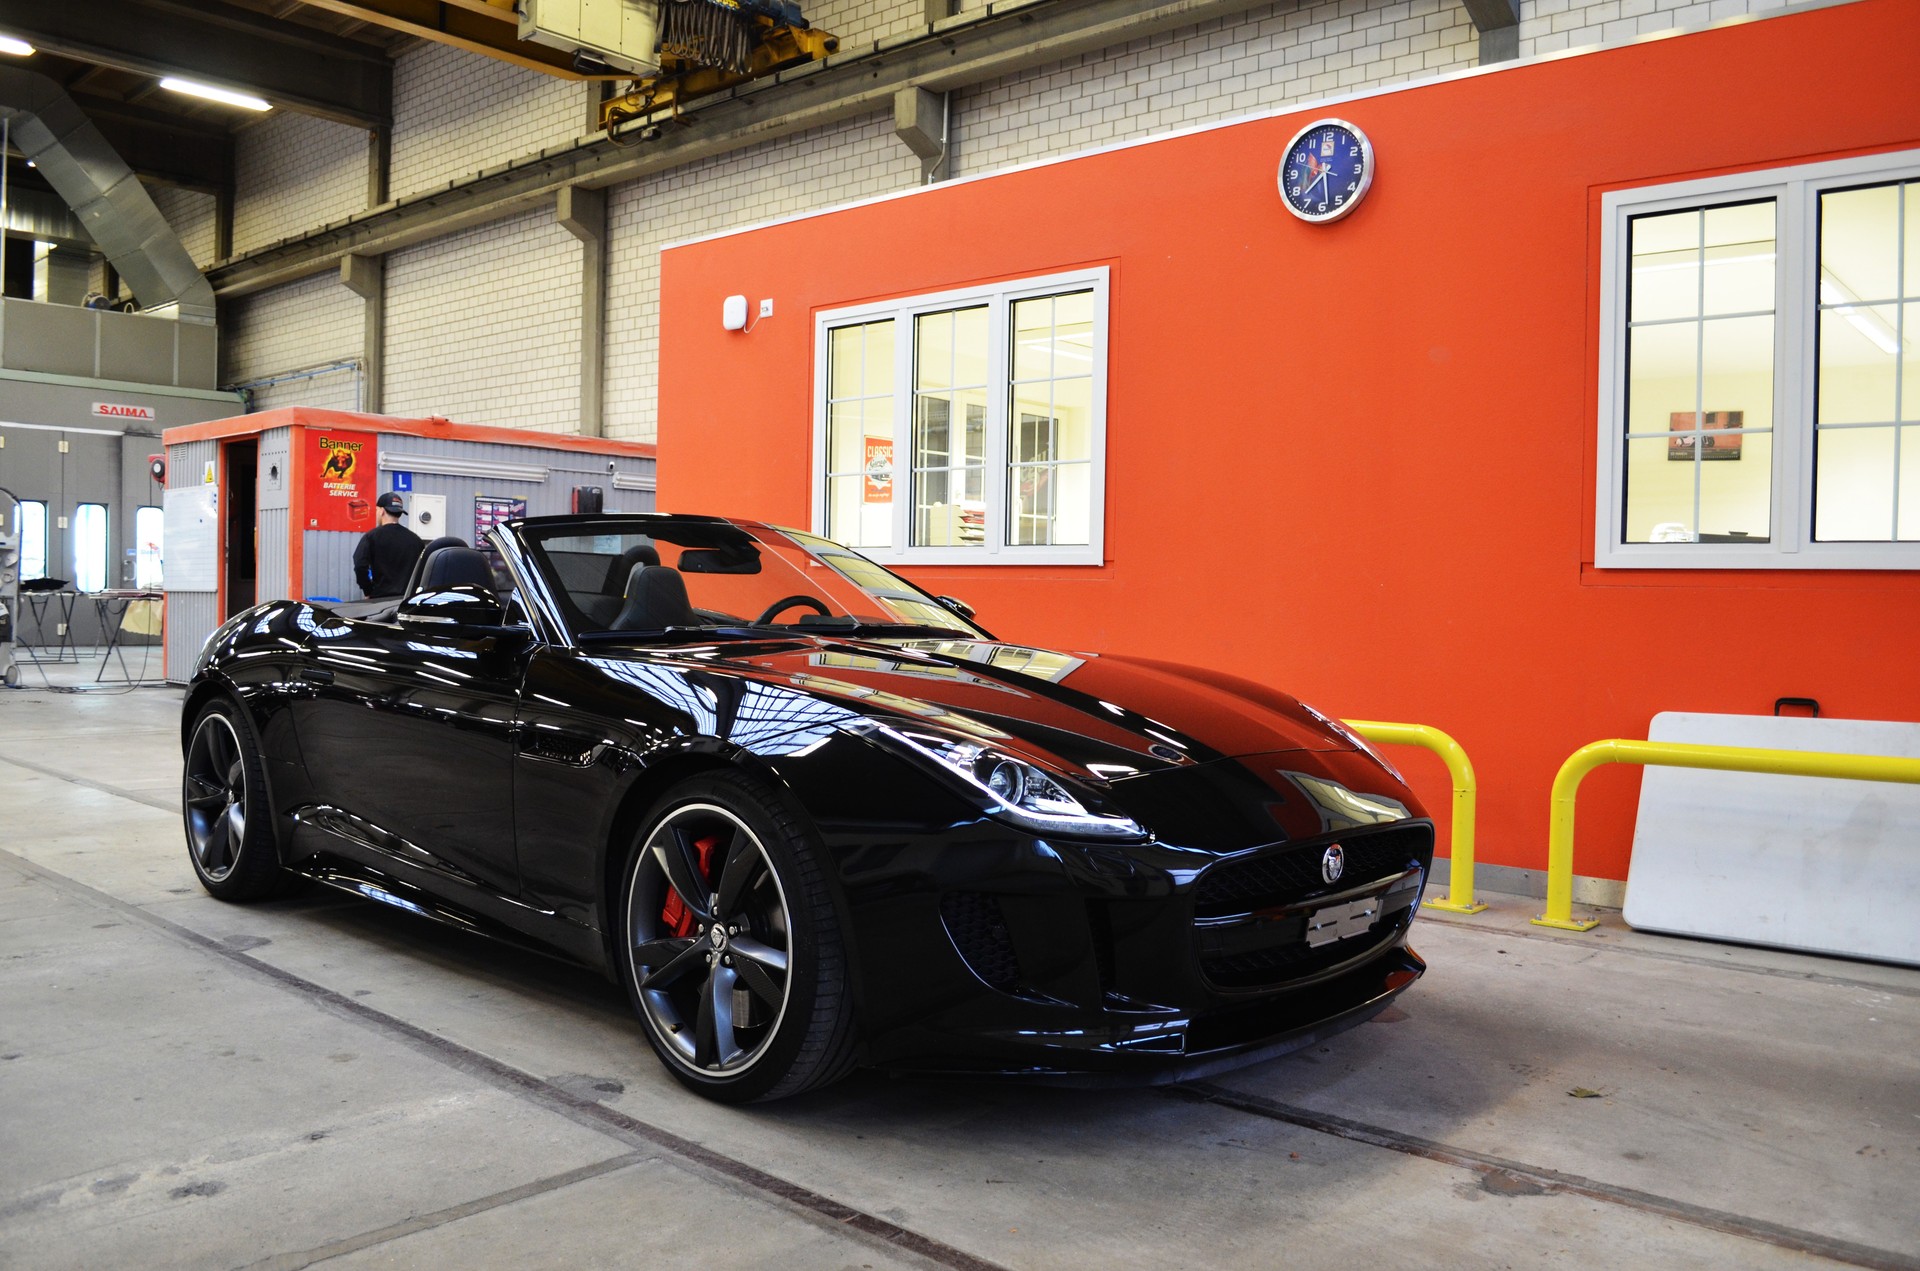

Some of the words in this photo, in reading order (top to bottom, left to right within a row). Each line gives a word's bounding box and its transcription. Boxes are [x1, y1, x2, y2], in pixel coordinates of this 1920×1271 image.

[1323, 132, 1334, 142] 12
[1341, 135, 1345, 145] 1
[1309, 139, 1316, 149] 11
[1350, 146, 1358, 157] 2
[1296, 153, 1306, 163] 10
[1353, 164, 1362, 174] 3
[1290, 170, 1298, 180] 9
[1292, 186, 1301, 196] 8
[1347, 182, 1356, 192] 4
[1303, 198, 1311, 209] 7
[1334, 195, 1343, 205] 5
[1318, 202, 1326, 212] 6
[99, 405, 148, 418] SAIMA
[320, 437, 363, 451] Banner
[867, 446, 893, 458] CLASSIC
[398, 474, 407, 488] L
[323, 482, 356, 491] BATTERIE
[329, 490, 358, 498] SERVICE
